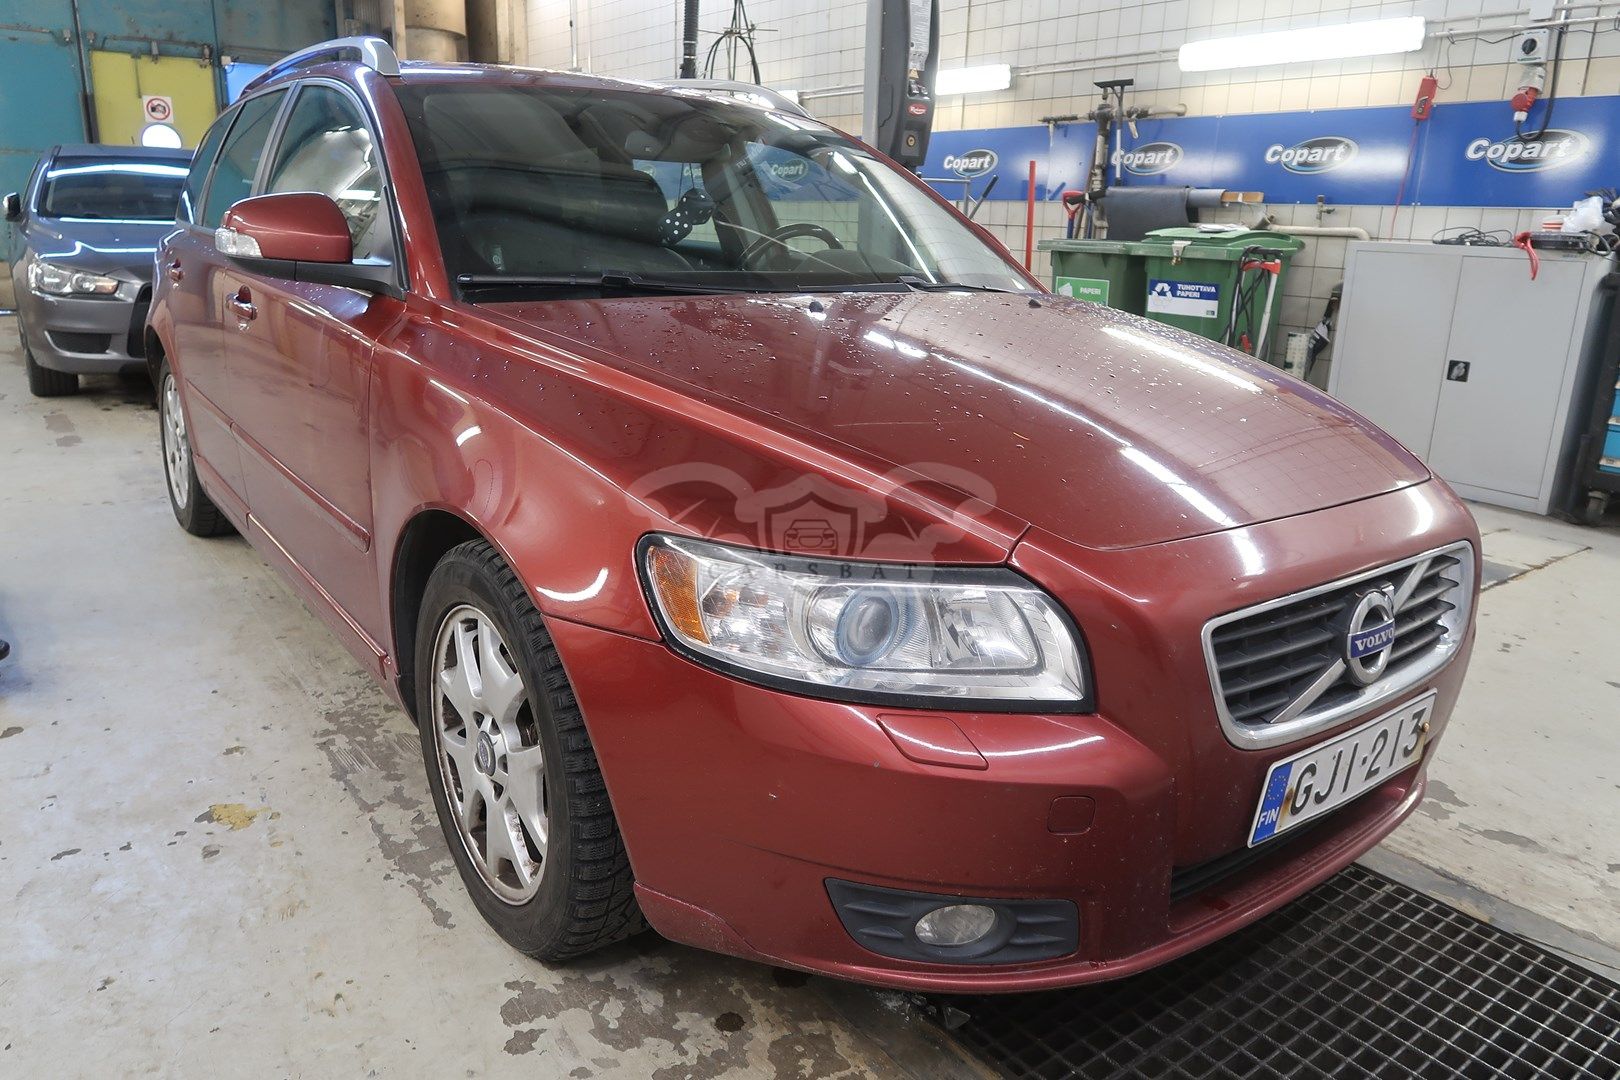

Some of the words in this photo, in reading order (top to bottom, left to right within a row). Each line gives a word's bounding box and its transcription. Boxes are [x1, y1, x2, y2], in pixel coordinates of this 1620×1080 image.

[1111, 147, 1174, 167] Copart
[1265, 143, 1348, 166] Copart
[1466, 136, 1573, 163] Copart
[771, 162, 804, 177] Copart
[943, 154, 992, 172] Copart
[1079, 286, 1102, 295] PAPERI
[1177, 284, 1217, 293] TUHOTTAVA
[1177, 290, 1201, 298] PAPERI
[1355, 627, 1395, 651] VOLVO
[1257, 807, 1279, 829] FIN
